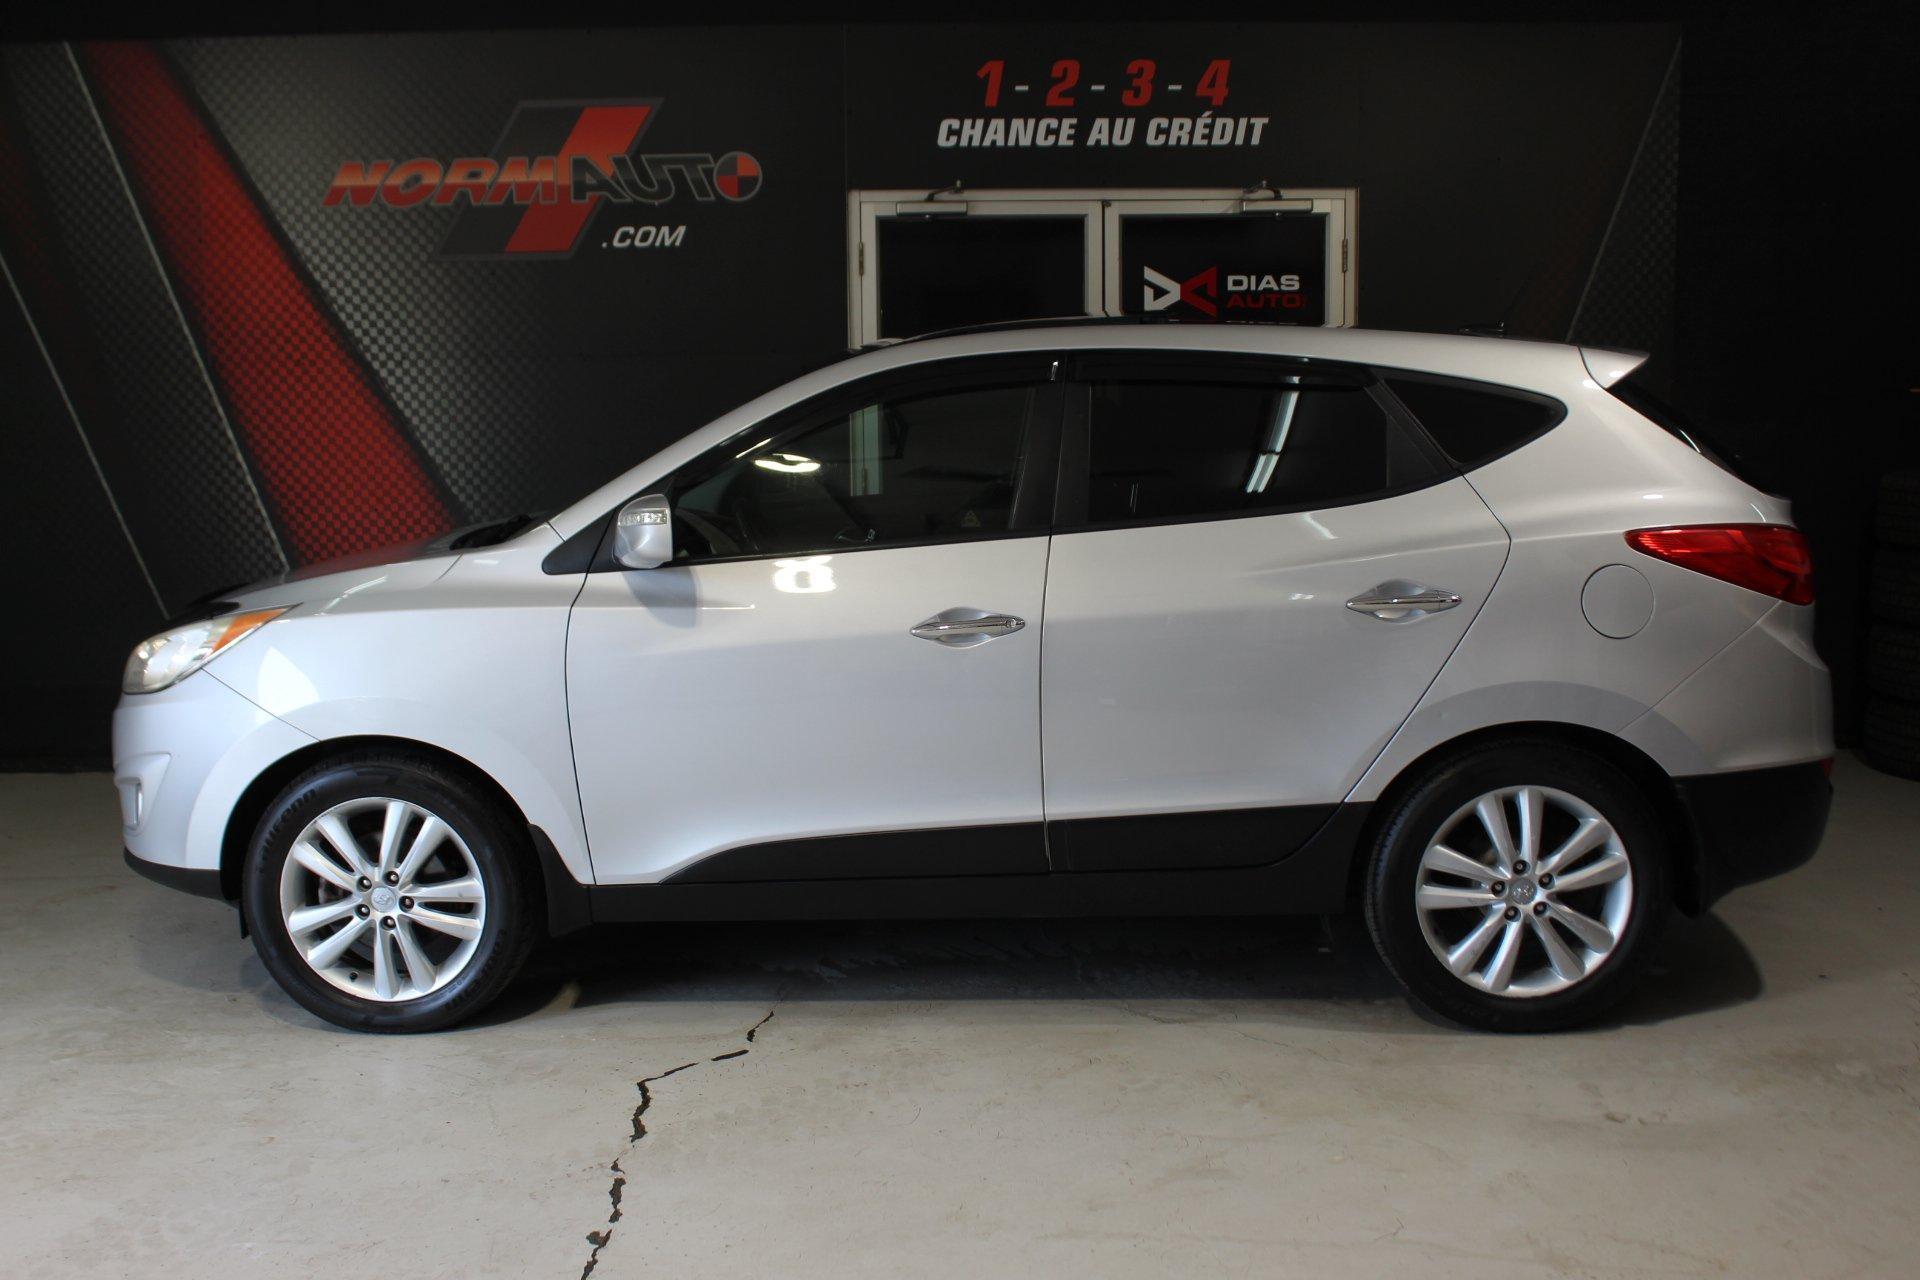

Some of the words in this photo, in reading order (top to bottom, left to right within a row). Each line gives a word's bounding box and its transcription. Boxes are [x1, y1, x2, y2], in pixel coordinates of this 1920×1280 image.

[937, 117, 1078, 148] CHANCE
[1086, 117, 1135, 146] AU
[1145, 111, 1270, 147] CRÉDIT
[1227, 275, 1301, 291] DIAS
[1226, 293, 1307, 309] AUTO
